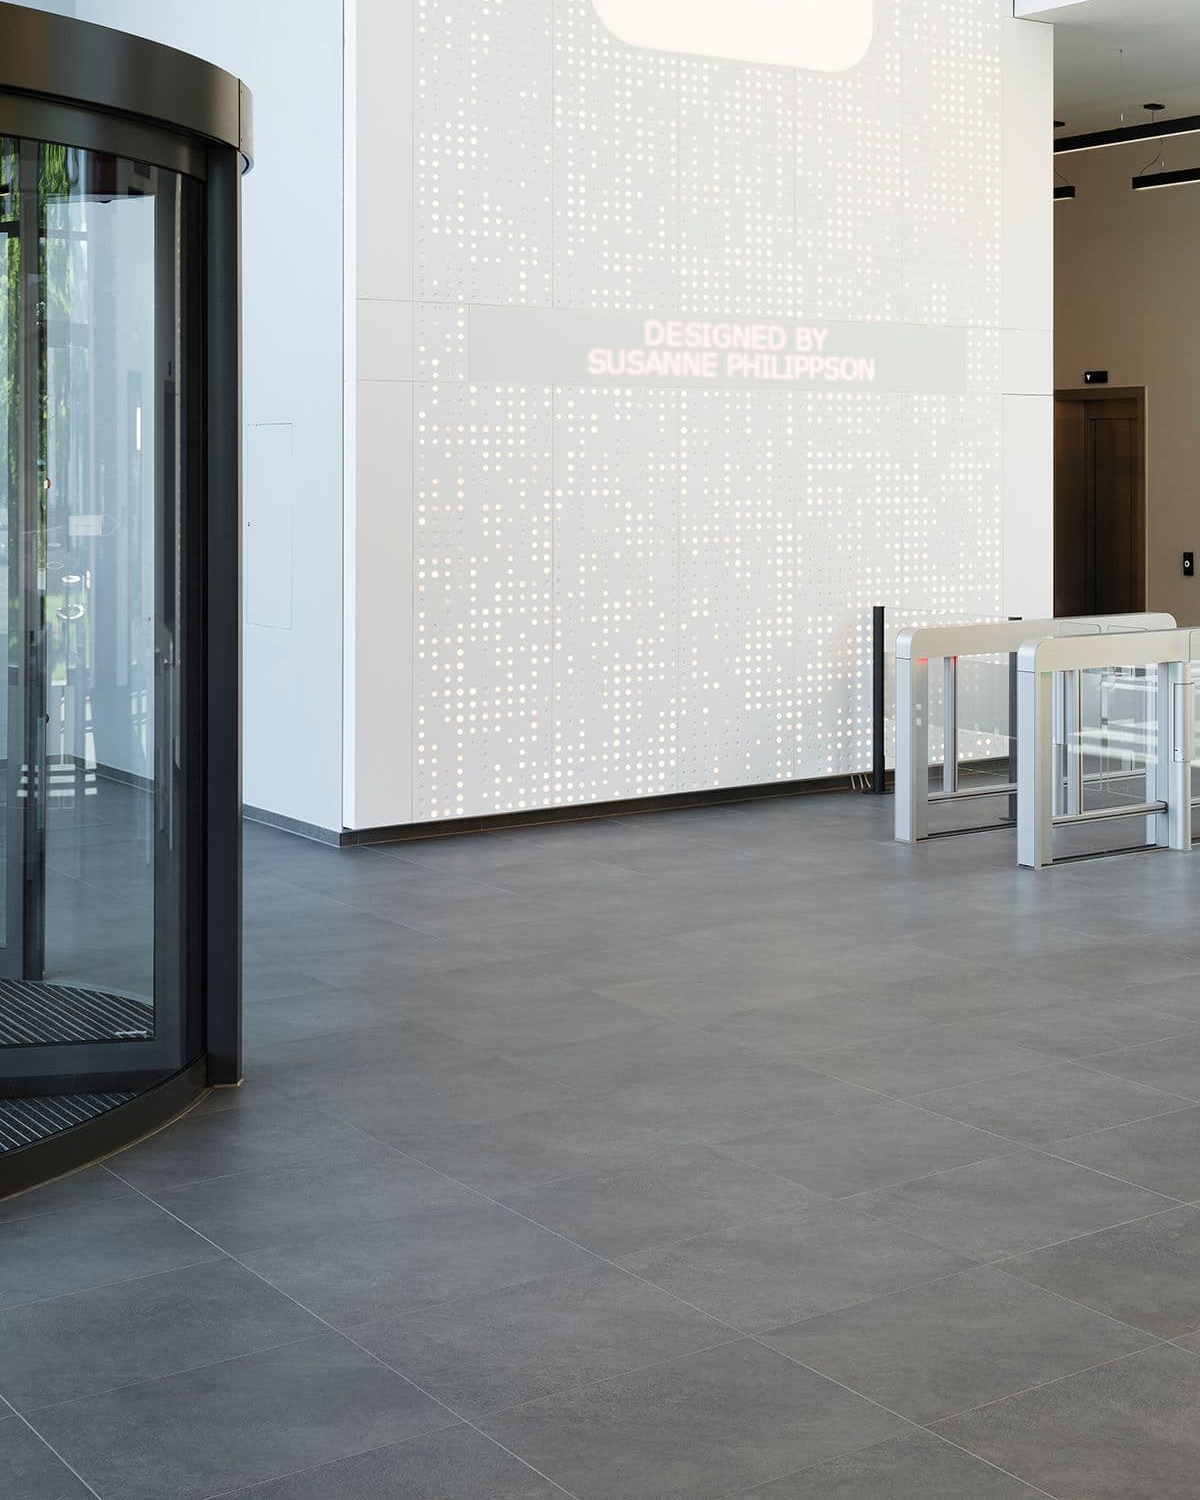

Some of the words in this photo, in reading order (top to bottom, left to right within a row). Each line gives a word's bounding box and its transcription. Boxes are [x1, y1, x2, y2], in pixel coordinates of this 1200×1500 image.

[643, 320, 787, 350] DESIGNED
[795, 325, 828, 352] BY
[587, 348, 718, 378] SUSANNE
[726, 353, 876, 381] PHILIPPSON
